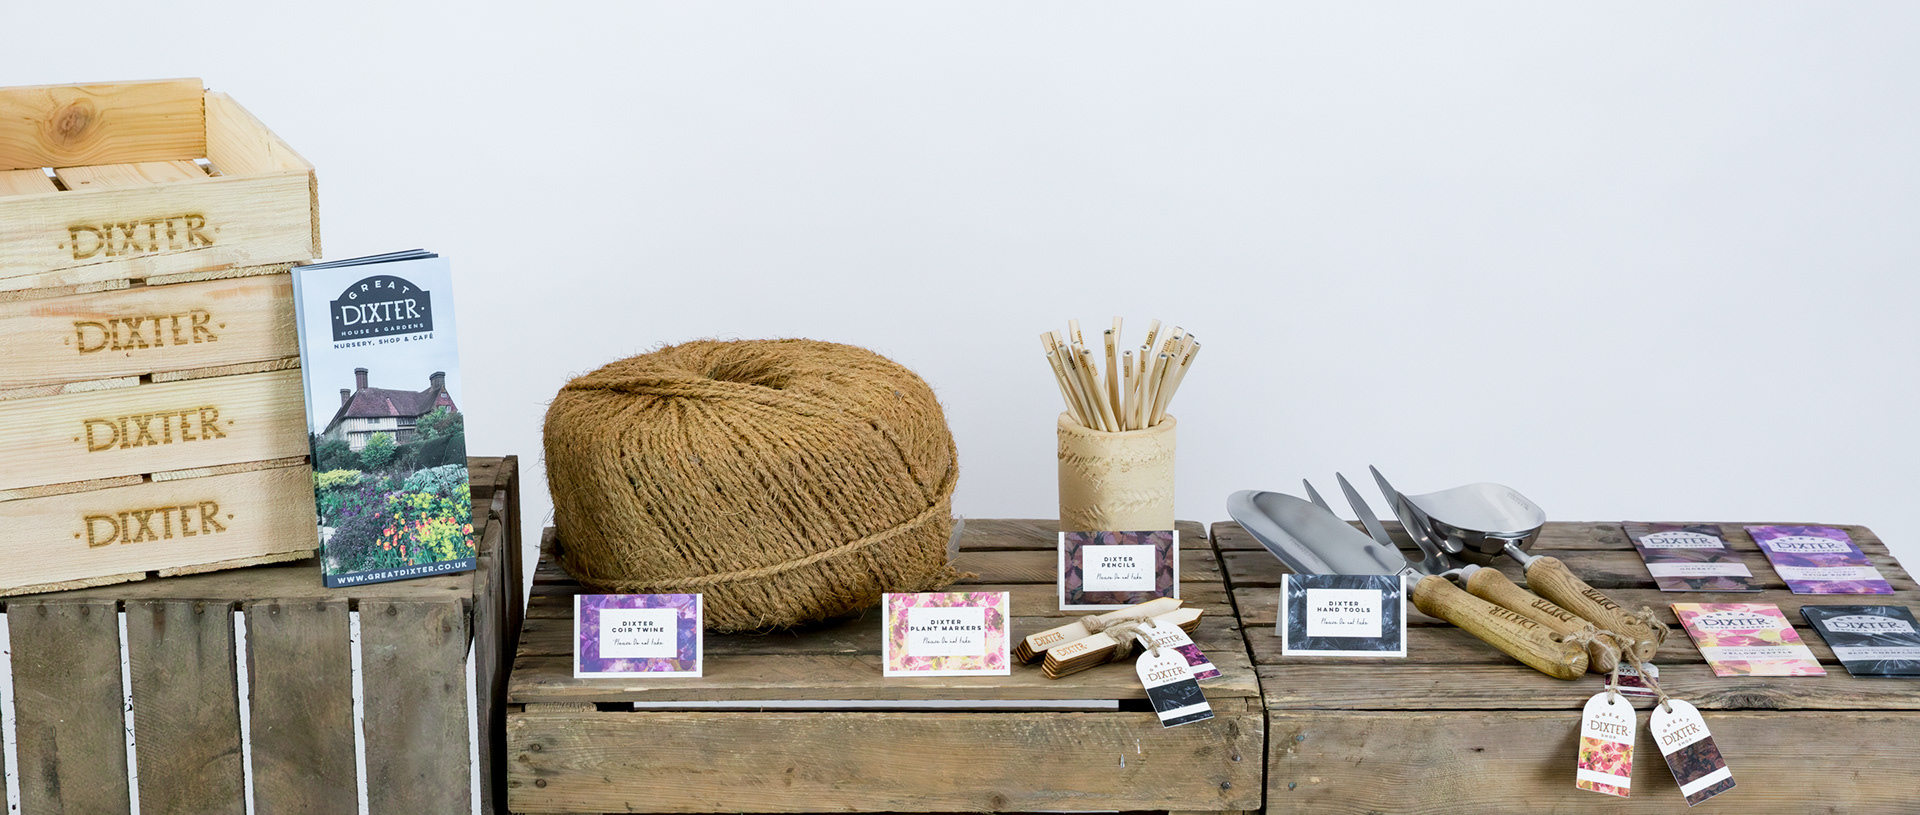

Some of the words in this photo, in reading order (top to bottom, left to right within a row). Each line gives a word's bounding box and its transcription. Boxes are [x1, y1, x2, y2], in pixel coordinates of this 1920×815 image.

[68, 214, 214, 260] DIXTER
[348, 280, 410, 300] GREAT
[341, 298, 420, 326] DIXTER
[74, 309, 218, 356] DIXTER
[341, 328, 370, 336] HOUSE
[384, 323, 424, 332] GARDENS
[334, 340, 375, 349] NURSERY,
[379, 337, 400, 345] SHOP
[413, 333, 434, 341] CAFÉ
[84, 406, 226, 453] DIXTER
[84, 501, 226, 548] DIXTER
[1649, 537, 1712, 545] DIXTER
[337, 561, 467, 584] WWW.GREATDIXTER.CO.UK
[1702, 618, 1771, 626] DIXTER
[1832, 621, 1901, 629] DIXTER
[1034, 631, 1065, 647] DIXTER
[1057, 643, 1088, 657] DIXTER
[1147, 666, 1186, 682] DIXTER
[1590, 719, 1629, 737] DIXTER
[1662, 722, 1700, 746] DIXTER
